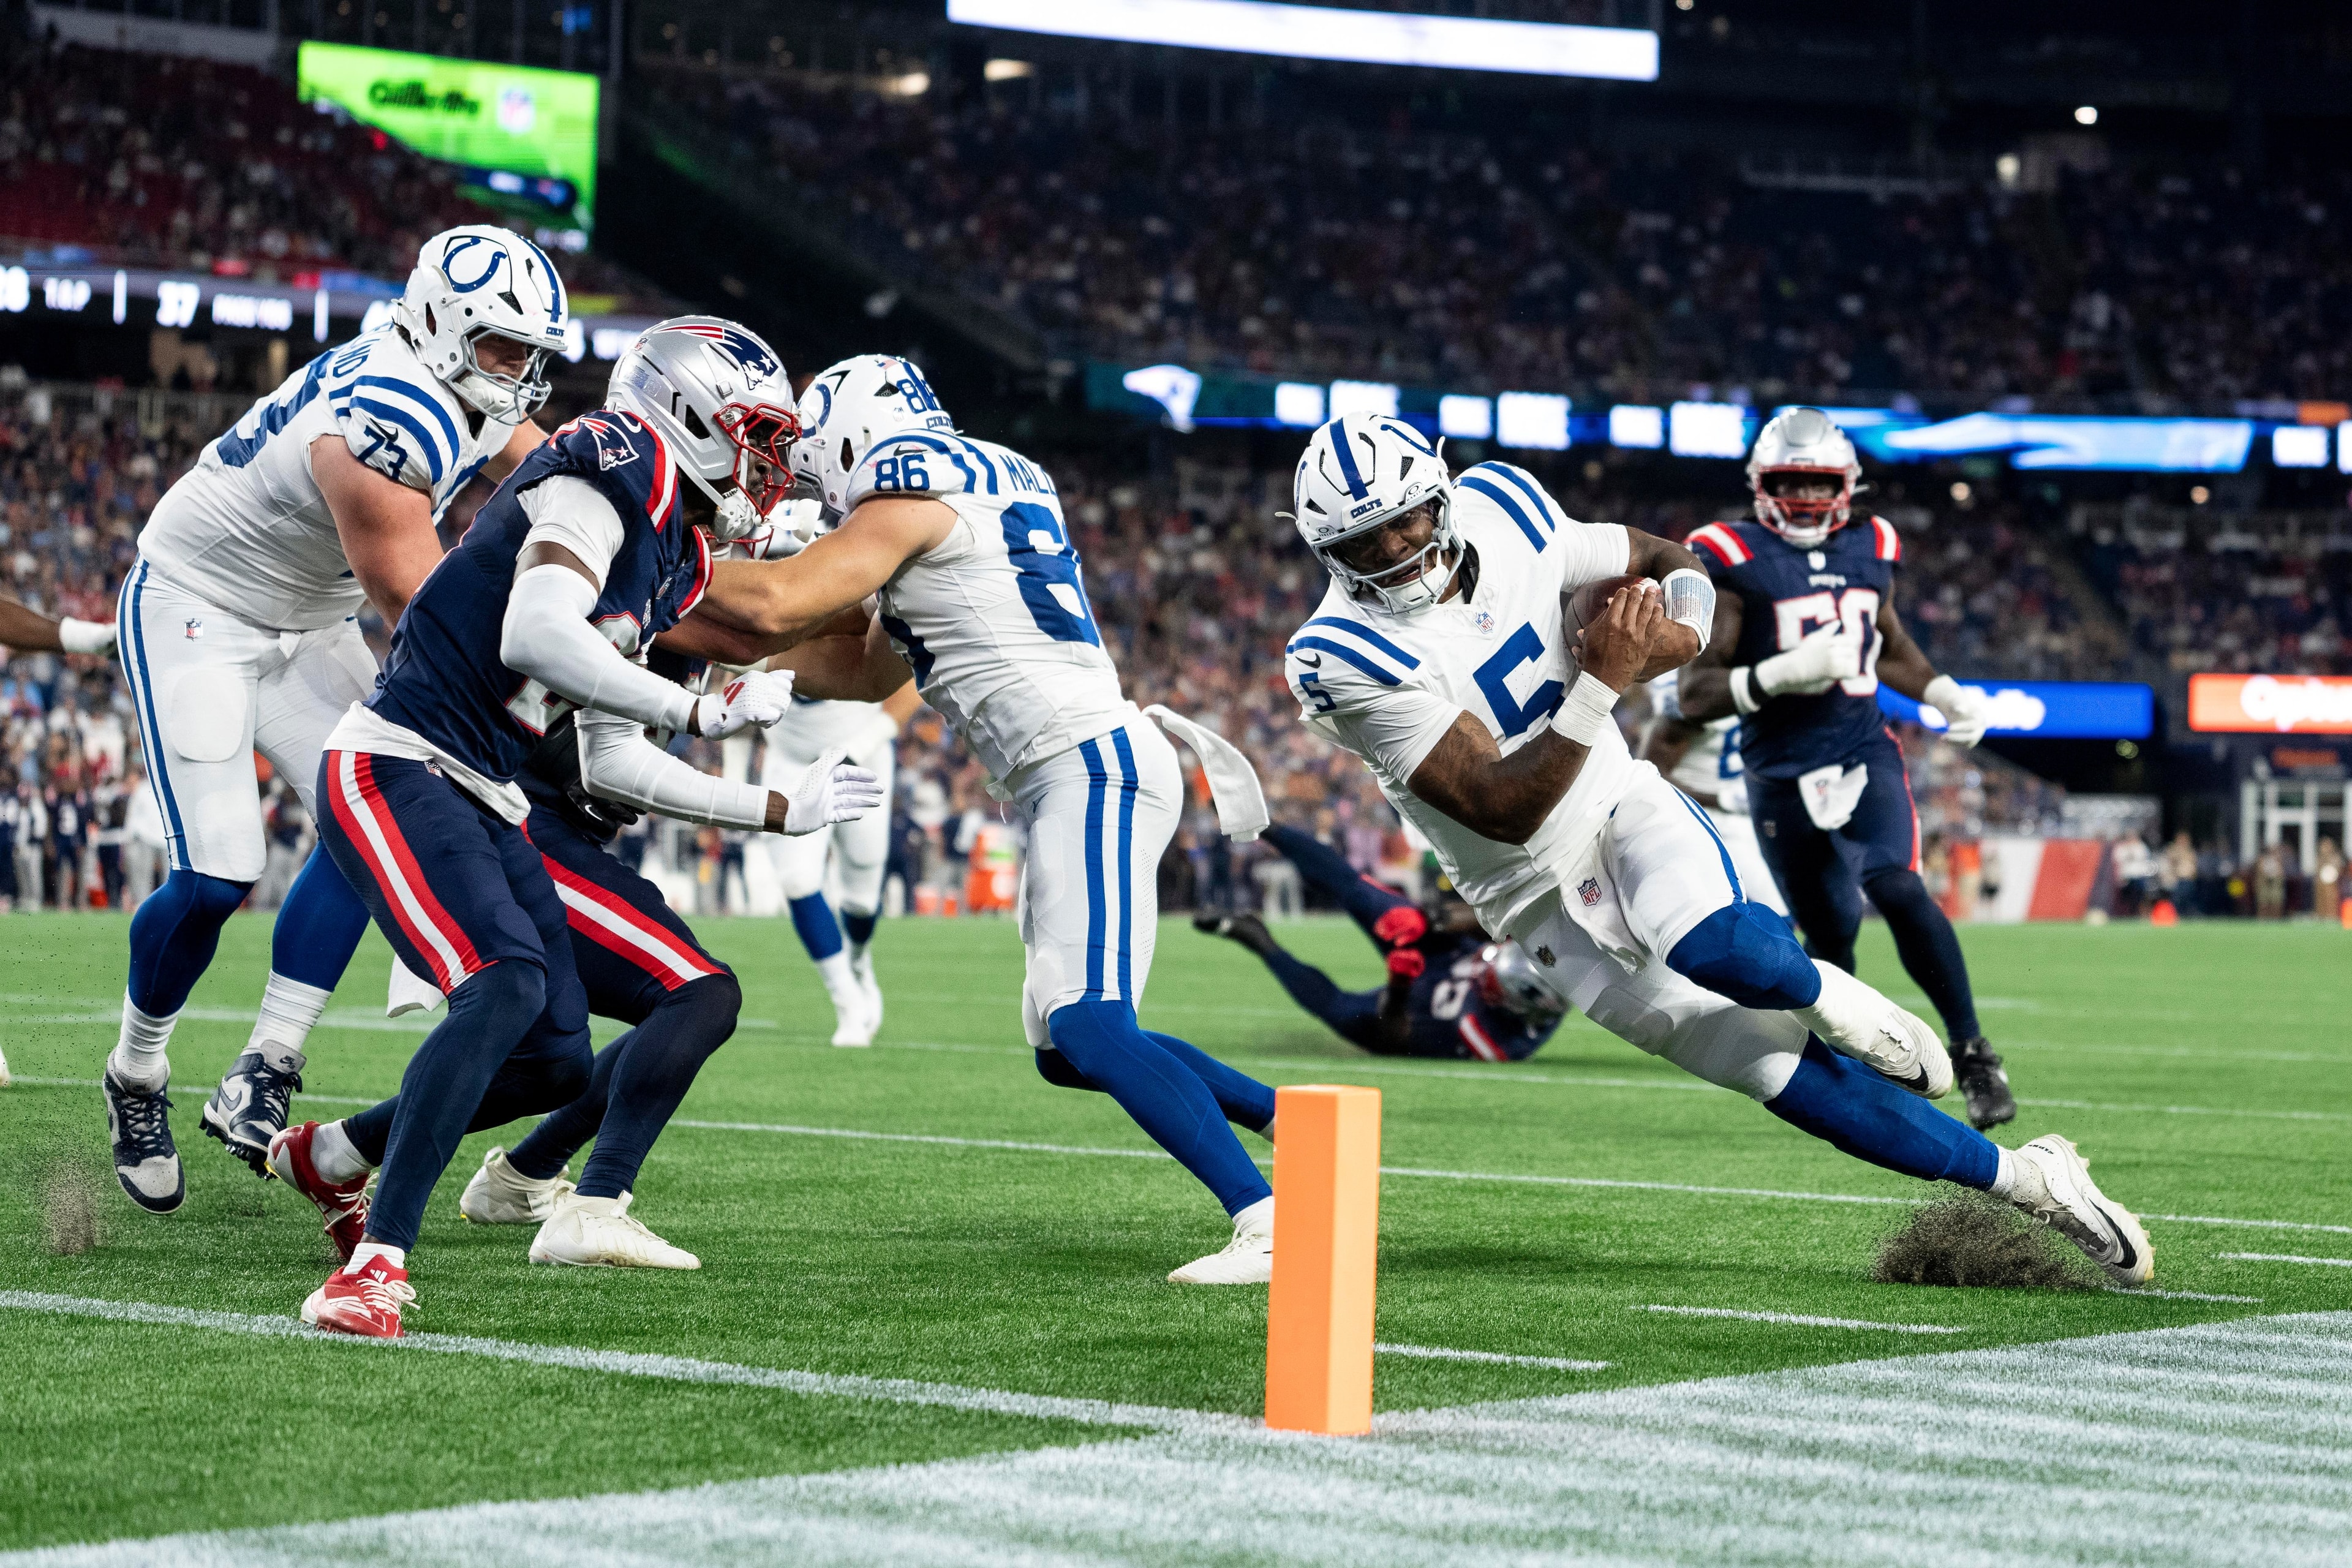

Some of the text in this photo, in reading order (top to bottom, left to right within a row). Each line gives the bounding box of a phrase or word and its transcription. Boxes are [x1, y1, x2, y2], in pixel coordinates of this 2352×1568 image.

[357, 425, 408, 480] 73
[874, 454, 930, 492] 86
[1350, 498, 1382, 519] COLTS
[1000, 501, 1102, 649] 8
[1480, 618, 1493, 631] NFL
[1298, 672, 1336, 712] 5
[1472, 621, 1566, 739] 5
[1583, 887, 1600, 905] NFL
